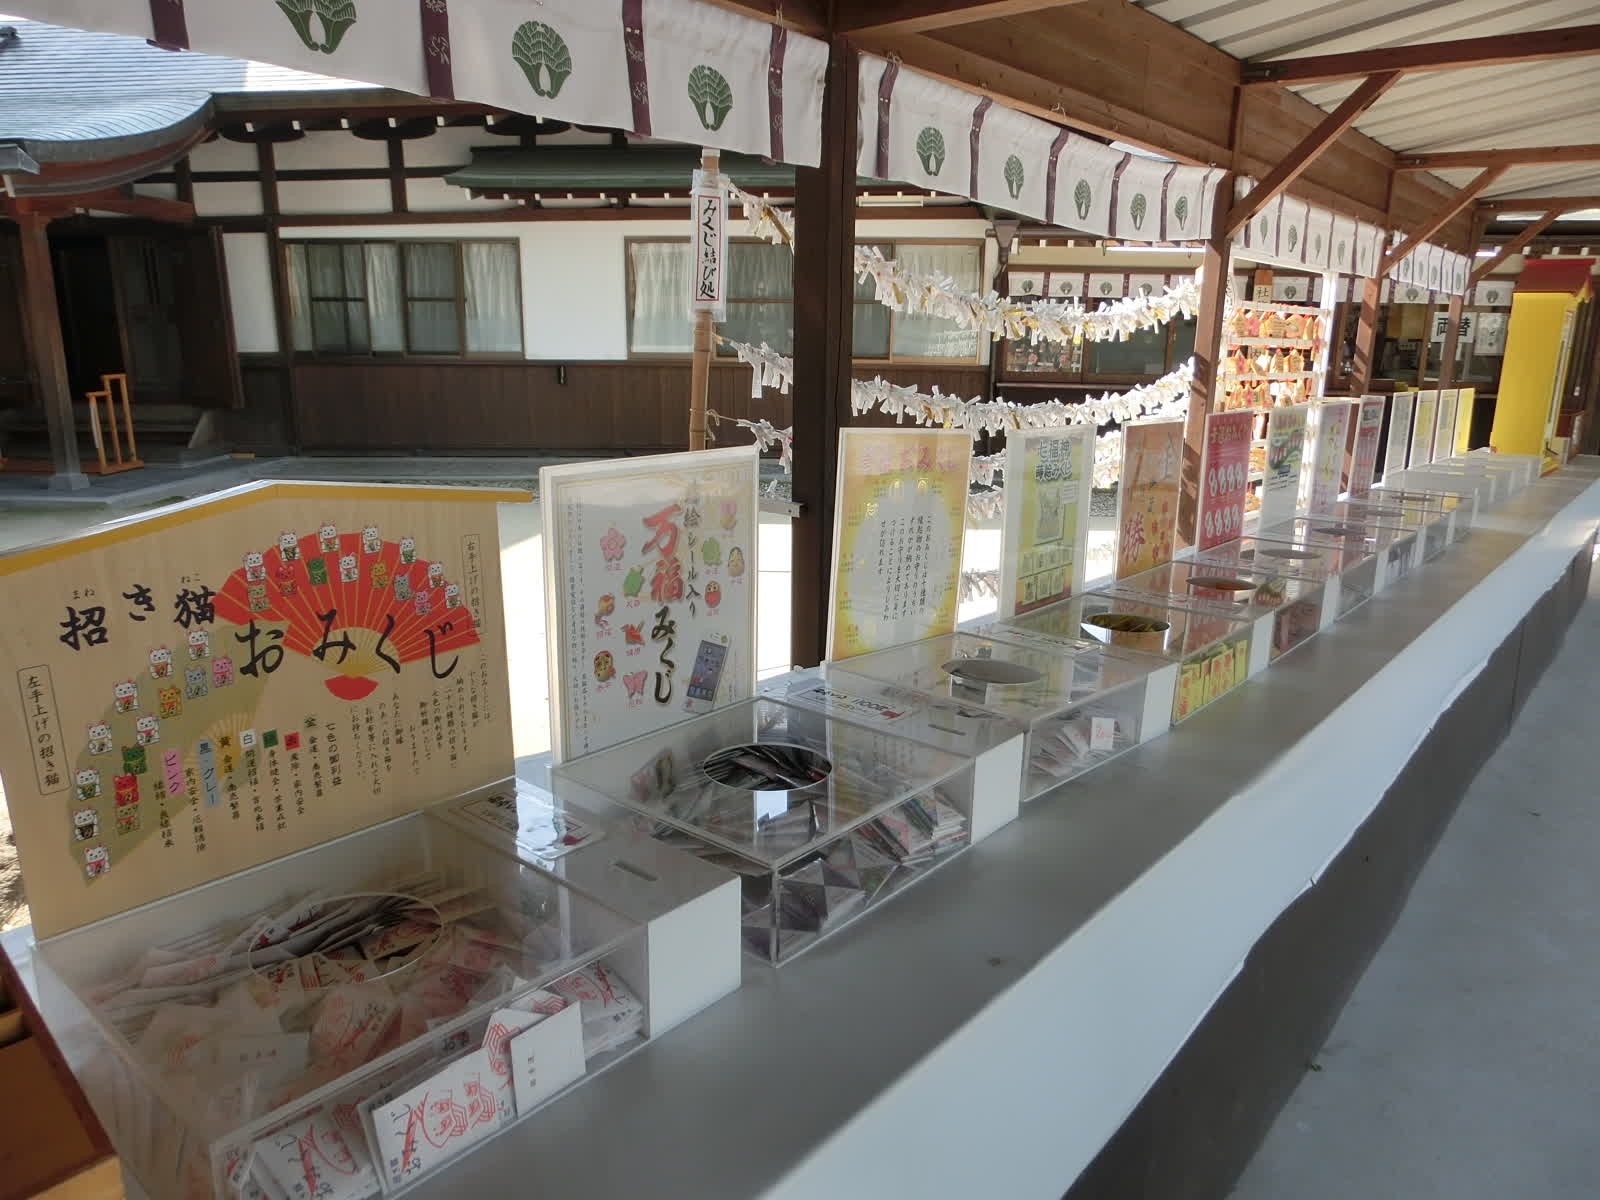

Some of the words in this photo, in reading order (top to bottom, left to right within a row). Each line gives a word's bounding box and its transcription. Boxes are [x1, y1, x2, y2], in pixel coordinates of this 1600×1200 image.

[700, 199, 717, 299] みくじ結び処
[181, 573, 201, 583] ねこ
[684, 482, 701, 618] 絵シール入り
[59, 584, 217, 651] 招き猫
[72, 588, 96, 600] まね
[234, 608, 459, 680] おみくじ
[28, 675, 60, 786] 左手上げの招き猫
[243, 734, 253, 744] 白
[164, 753, 180, 793] ピンク
